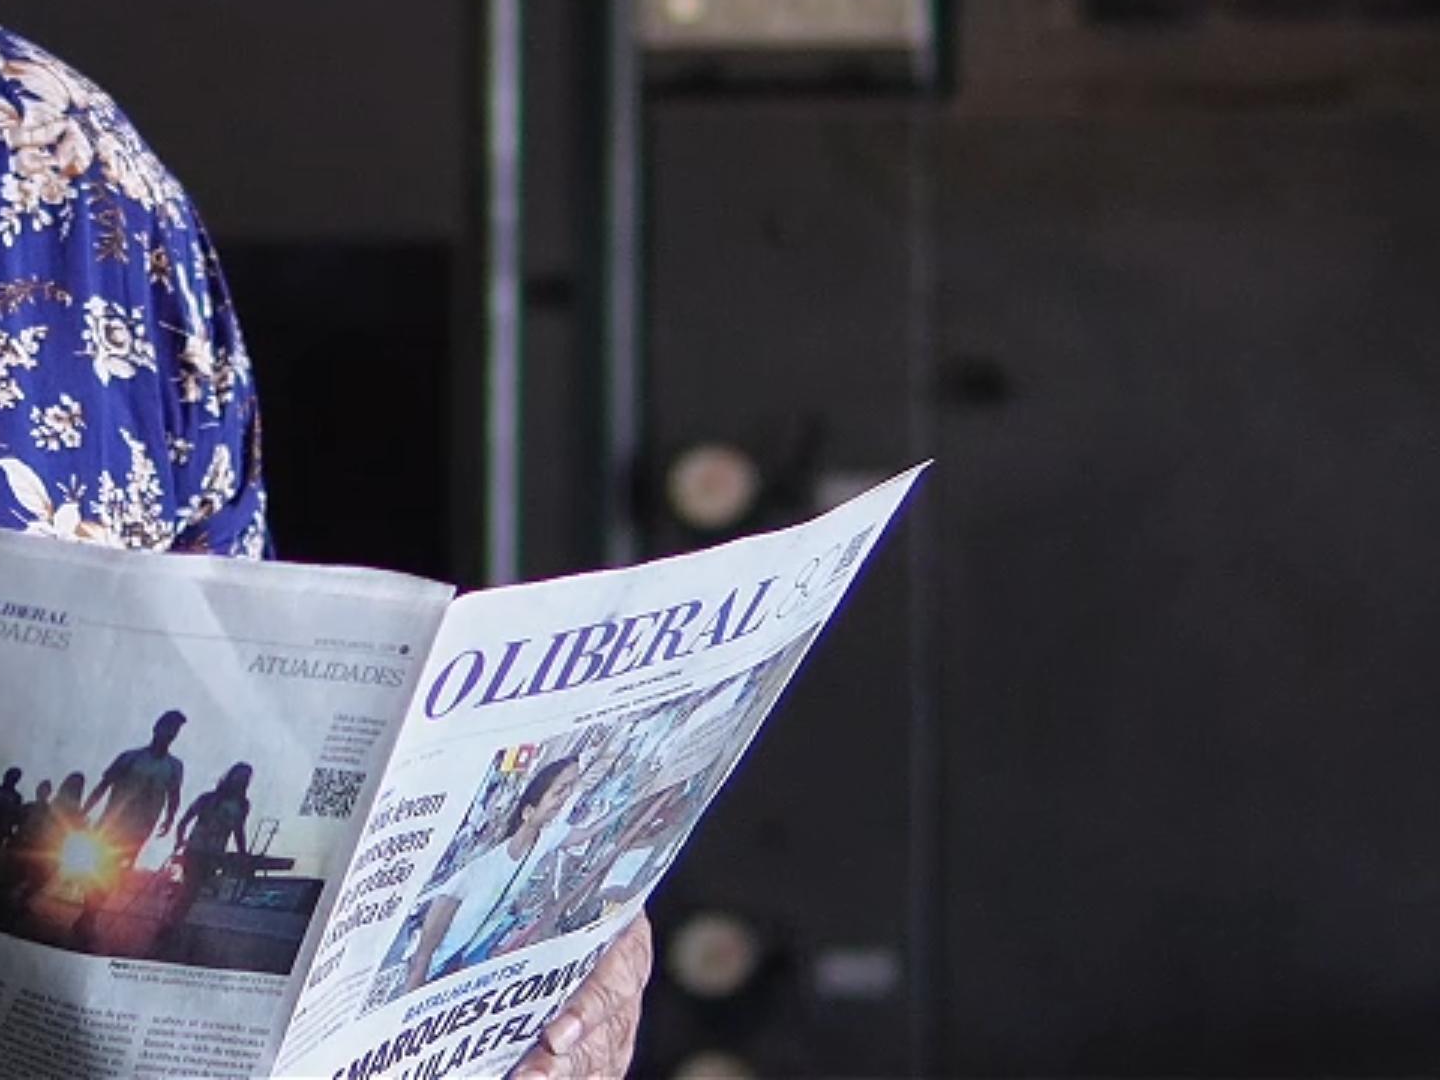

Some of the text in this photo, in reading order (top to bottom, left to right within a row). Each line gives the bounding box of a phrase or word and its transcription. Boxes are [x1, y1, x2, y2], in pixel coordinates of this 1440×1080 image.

[247, 653, 406, 688] ATUALIDADES
[474, 575, 781, 709] LIBERAL
[347, 988, 498, 1080] MARQUES
